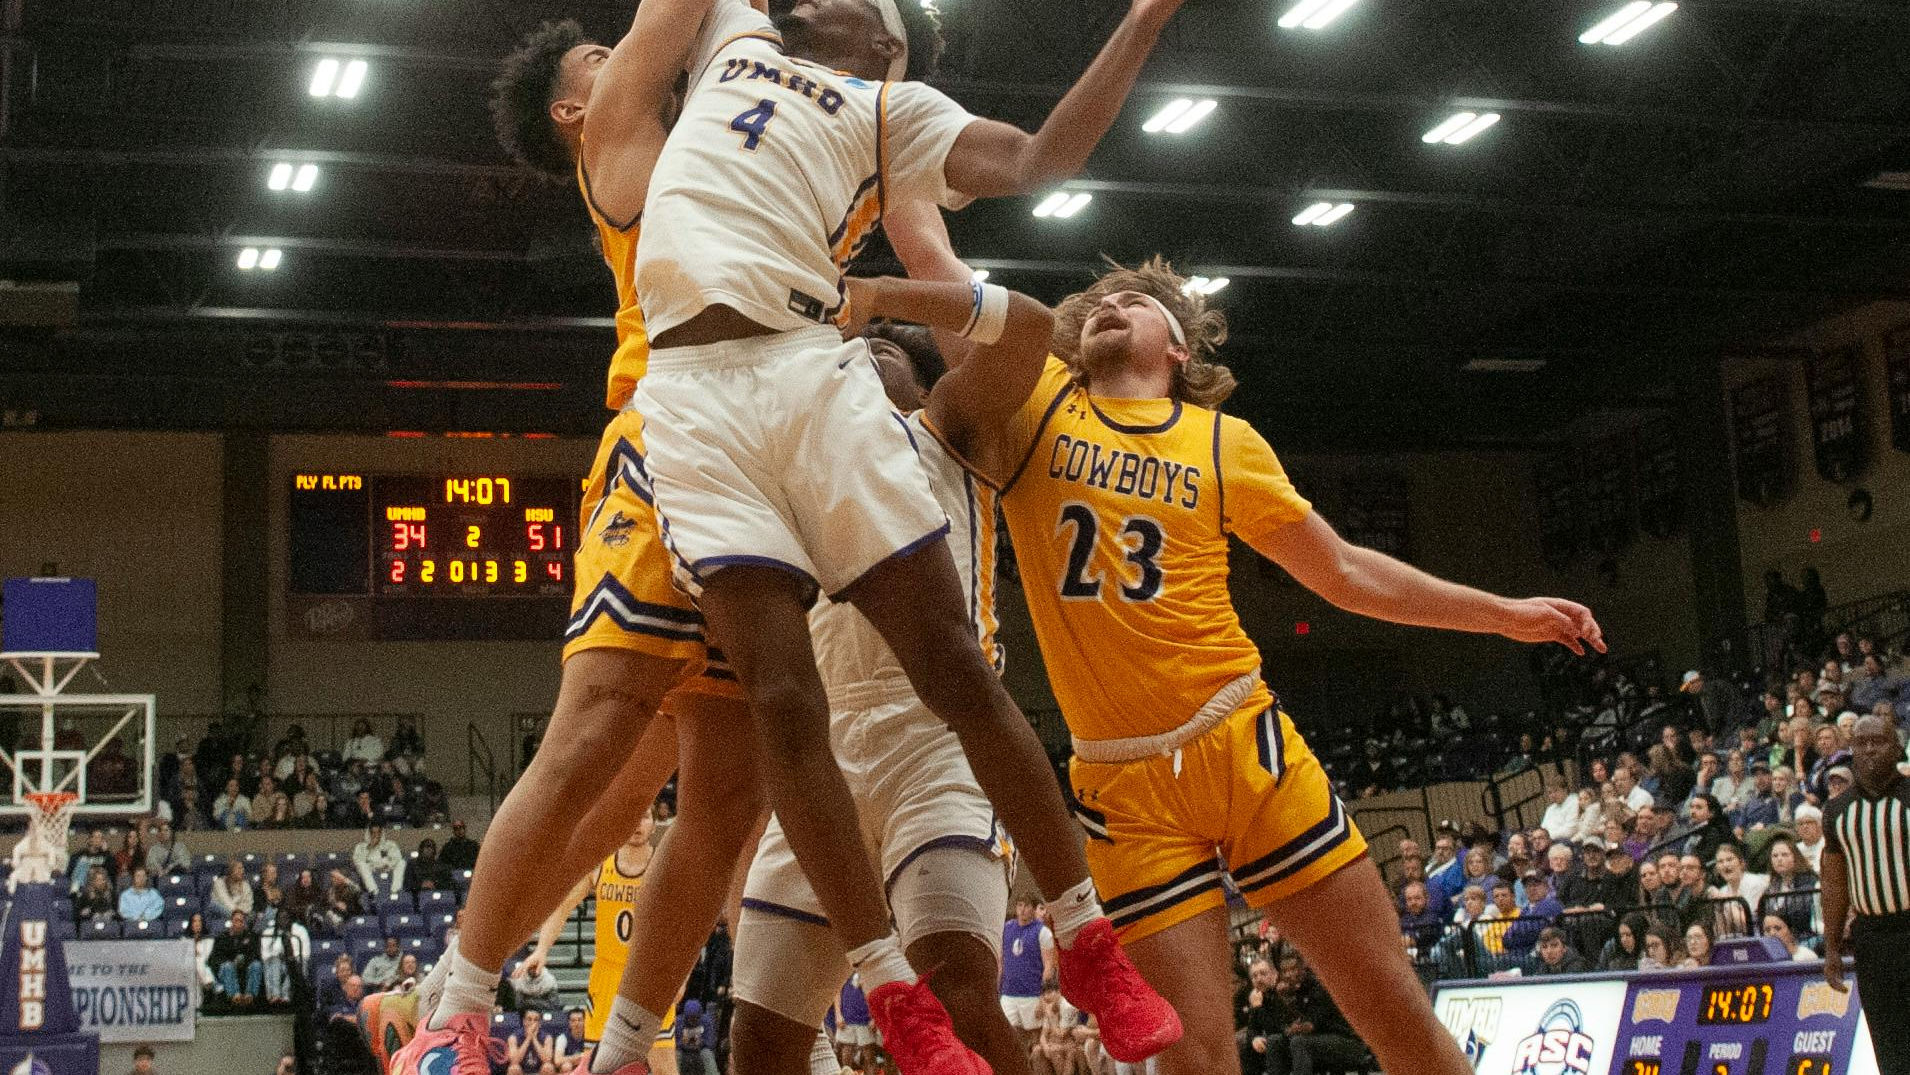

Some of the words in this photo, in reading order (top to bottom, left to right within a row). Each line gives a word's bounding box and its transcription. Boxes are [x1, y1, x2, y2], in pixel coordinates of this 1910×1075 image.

[728, 98, 779, 153] 4
[322, 475, 337, 490] FL
[1049, 433, 1201, 510] COWBOYS
[447, 477, 510, 504] 14:07
[393, 524, 426, 550] 34
[466, 525, 481, 548] 2
[528, 524, 562, 550] 51
[1057, 500, 1165, 602] 23
[391, 560, 406, 583] 2
[421, 560, 435, 583] 2
[514, 561, 527, 583] 3
[548, 562, 562, 581] 4
[615, 909, 634, 943] 0
[19, 920, 48, 1031] UMHB
[92, 964, 113, 976] TO
[118, 964, 150, 976] THE
[71, 985, 189, 1026] PIONSHIP
[1707, 984, 1774, 1023] 14:07
[1512, 1028, 1595, 1074] ASC
[1629, 1035, 1664, 1056] HOME
[1708, 1042, 1743, 1060] PERIOD
[1793, 1030, 1837, 1053] GUEST
